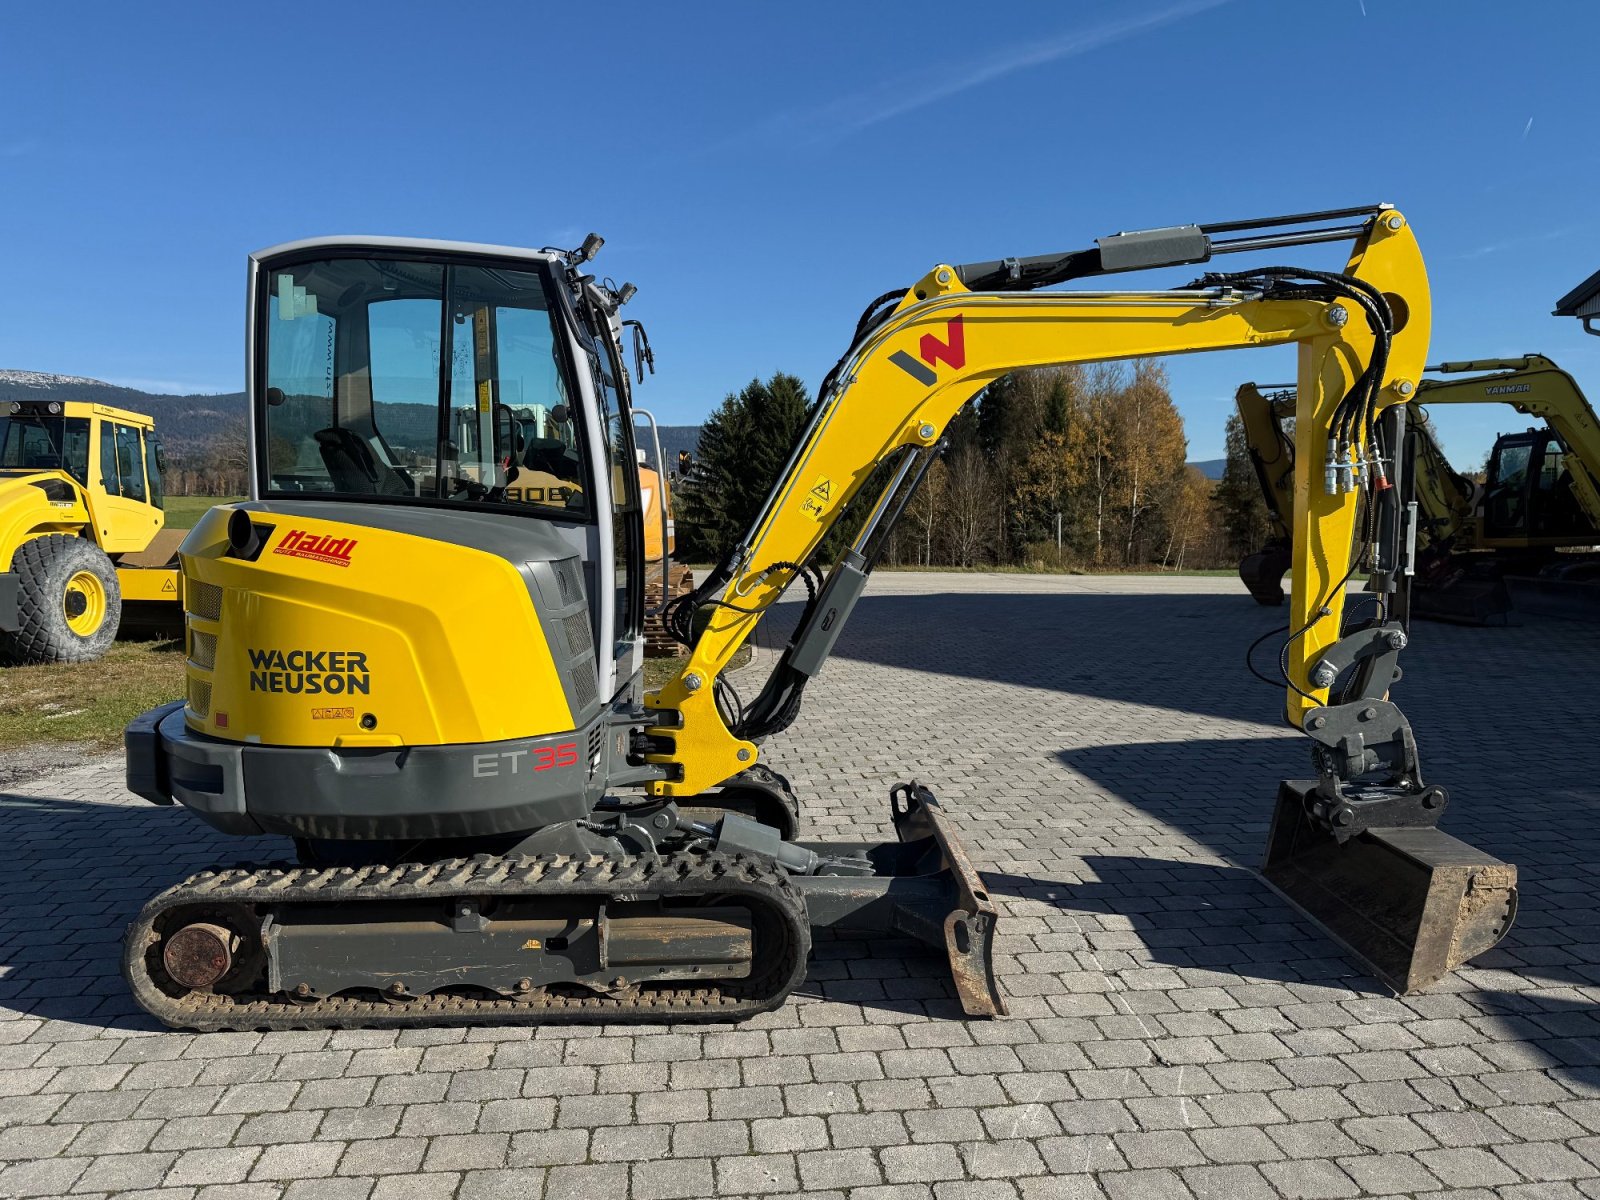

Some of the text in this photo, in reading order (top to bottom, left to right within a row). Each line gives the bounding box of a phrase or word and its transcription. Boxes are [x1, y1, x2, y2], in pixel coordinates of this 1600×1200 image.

[1485, 384, 1530, 395] YANMAR
[278, 529, 358, 560] Haidl
[248, 649, 370, 672] WACKER
[249, 671, 370, 695] NEUSON
[473, 743, 579, 778] ET 35
